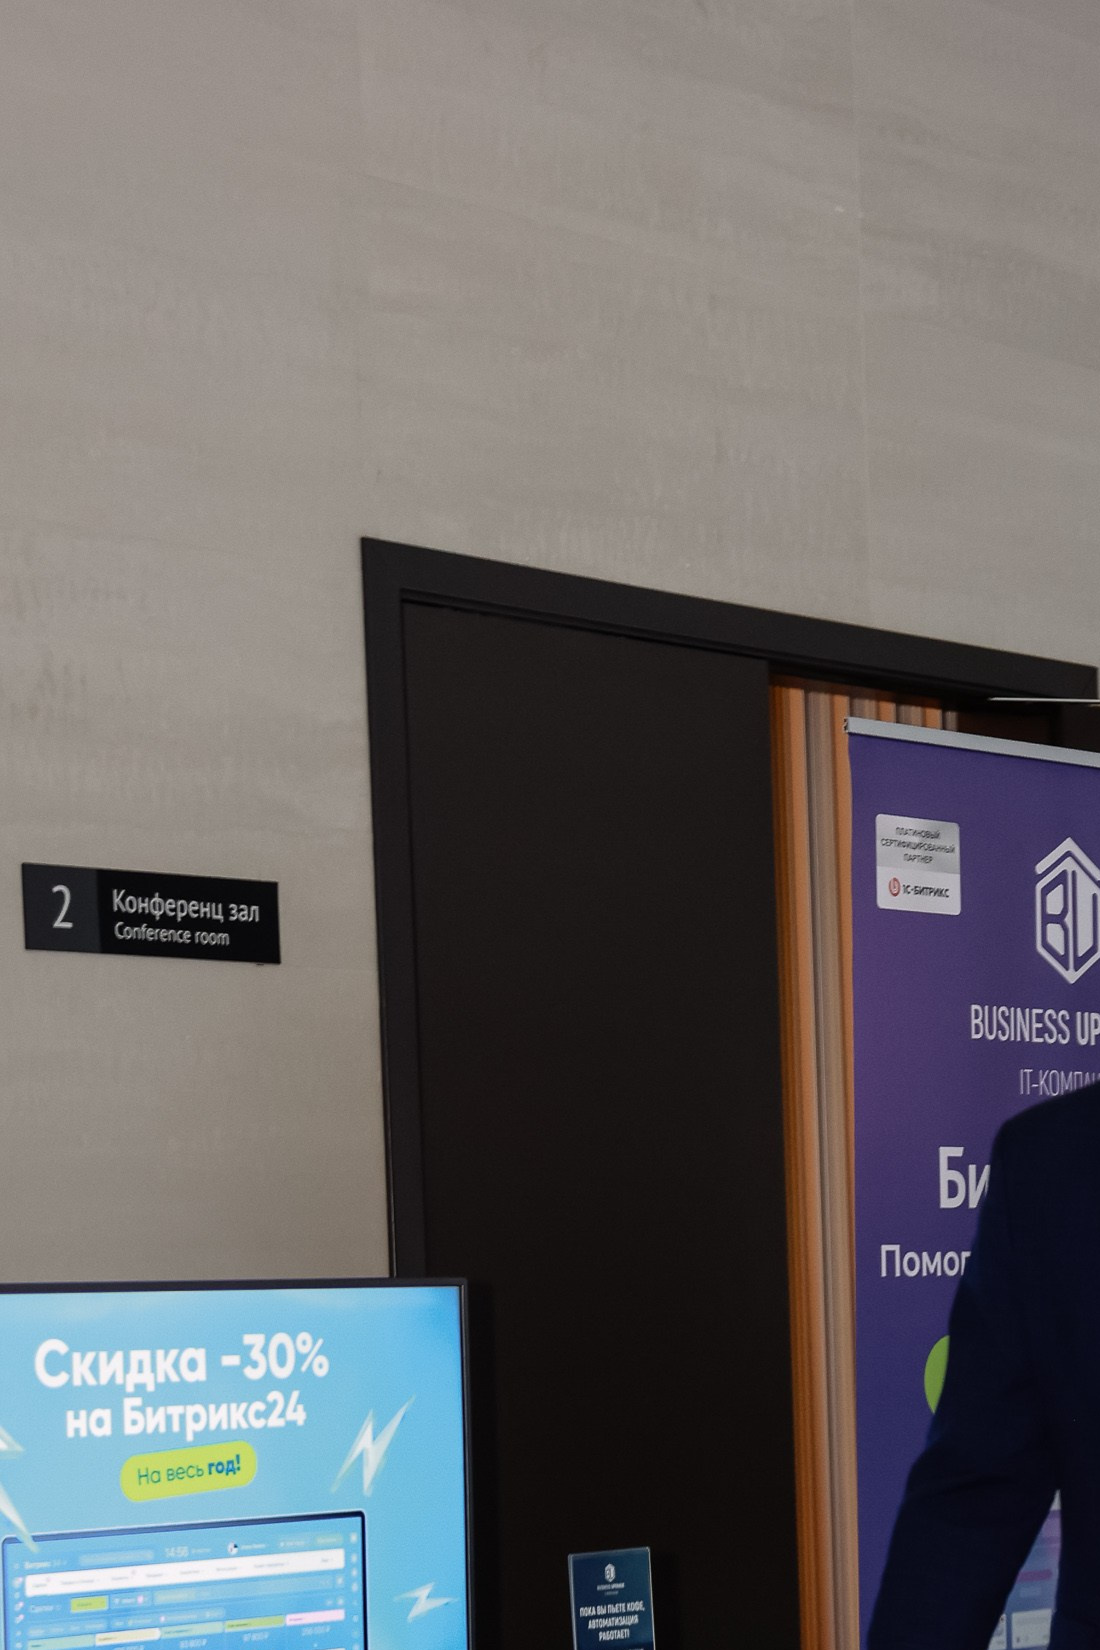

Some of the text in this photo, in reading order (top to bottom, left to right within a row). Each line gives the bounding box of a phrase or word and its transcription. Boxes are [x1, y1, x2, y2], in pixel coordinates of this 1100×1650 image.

[52, 884, 74, 929] 2
[112, 888, 260, 923] Конференц зал
[114, 921, 230, 946] Conference room
[970, 1004, 1071, 1045] BUSINESS
[880, 1244, 972, 1278] Помог
[35, 1331, 329, 1392] Скидка -30%
[66, 1390, 307, 1441] на Битрикс24
[137, 1454, 241, 1486] На весь год!
[580, 1606, 596, 1617] ПОКА
[597, 1604, 606, 1615] ВЫ
[607, 1602, 626, 1614] ПЬЕТЕ
[588, 1614, 639, 1630] АВТОМАТИЗАЦИЯ
[598, 1628, 630, 1642] РАБОТАЕТ!
